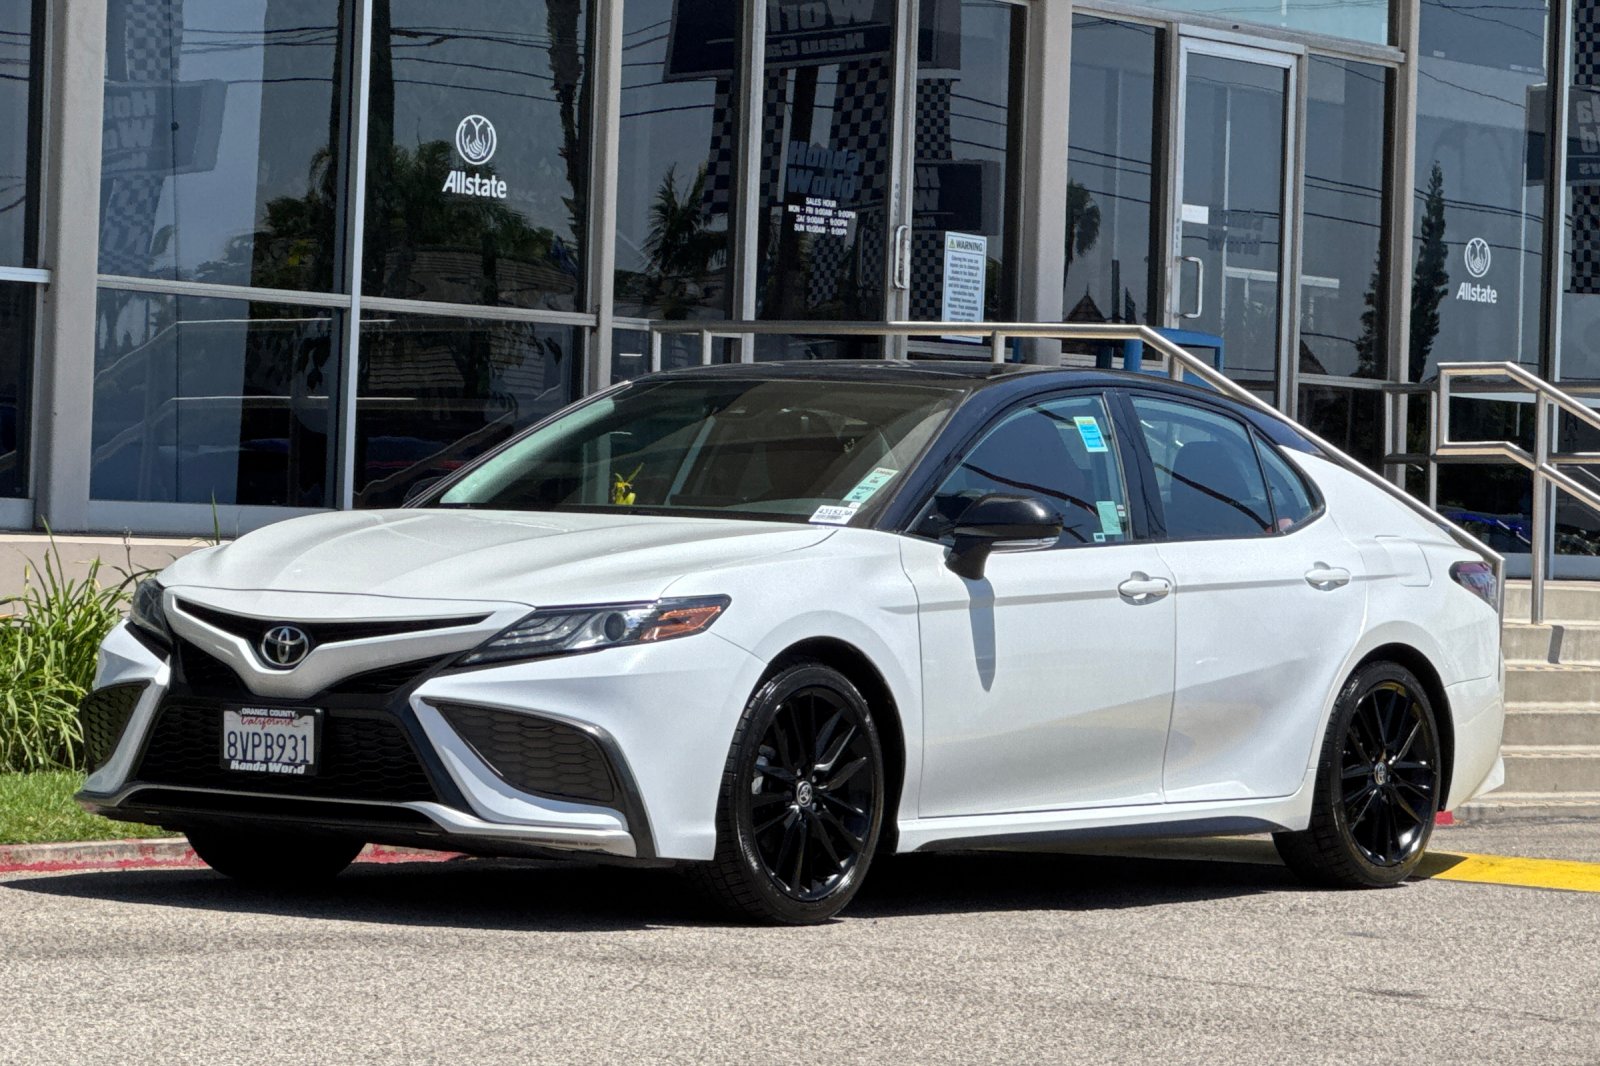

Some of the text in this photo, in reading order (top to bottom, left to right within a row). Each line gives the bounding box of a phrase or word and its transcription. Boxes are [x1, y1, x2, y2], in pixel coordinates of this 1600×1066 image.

[787, 141, 860, 173] Honda
[441, 170, 507, 199] Allstate
[787, 168, 856, 199] World
[805, 197, 821, 206] SALES
[956, 240, 983, 252] WARNING
[1455, 282, 1498, 304] Allstate
[241, 707, 297, 718] ORANGE COUNTY
[240, 717, 297, 730] California
[227, 730, 310, 764] 8VPB931
[230, 760, 306, 775] Honda World
